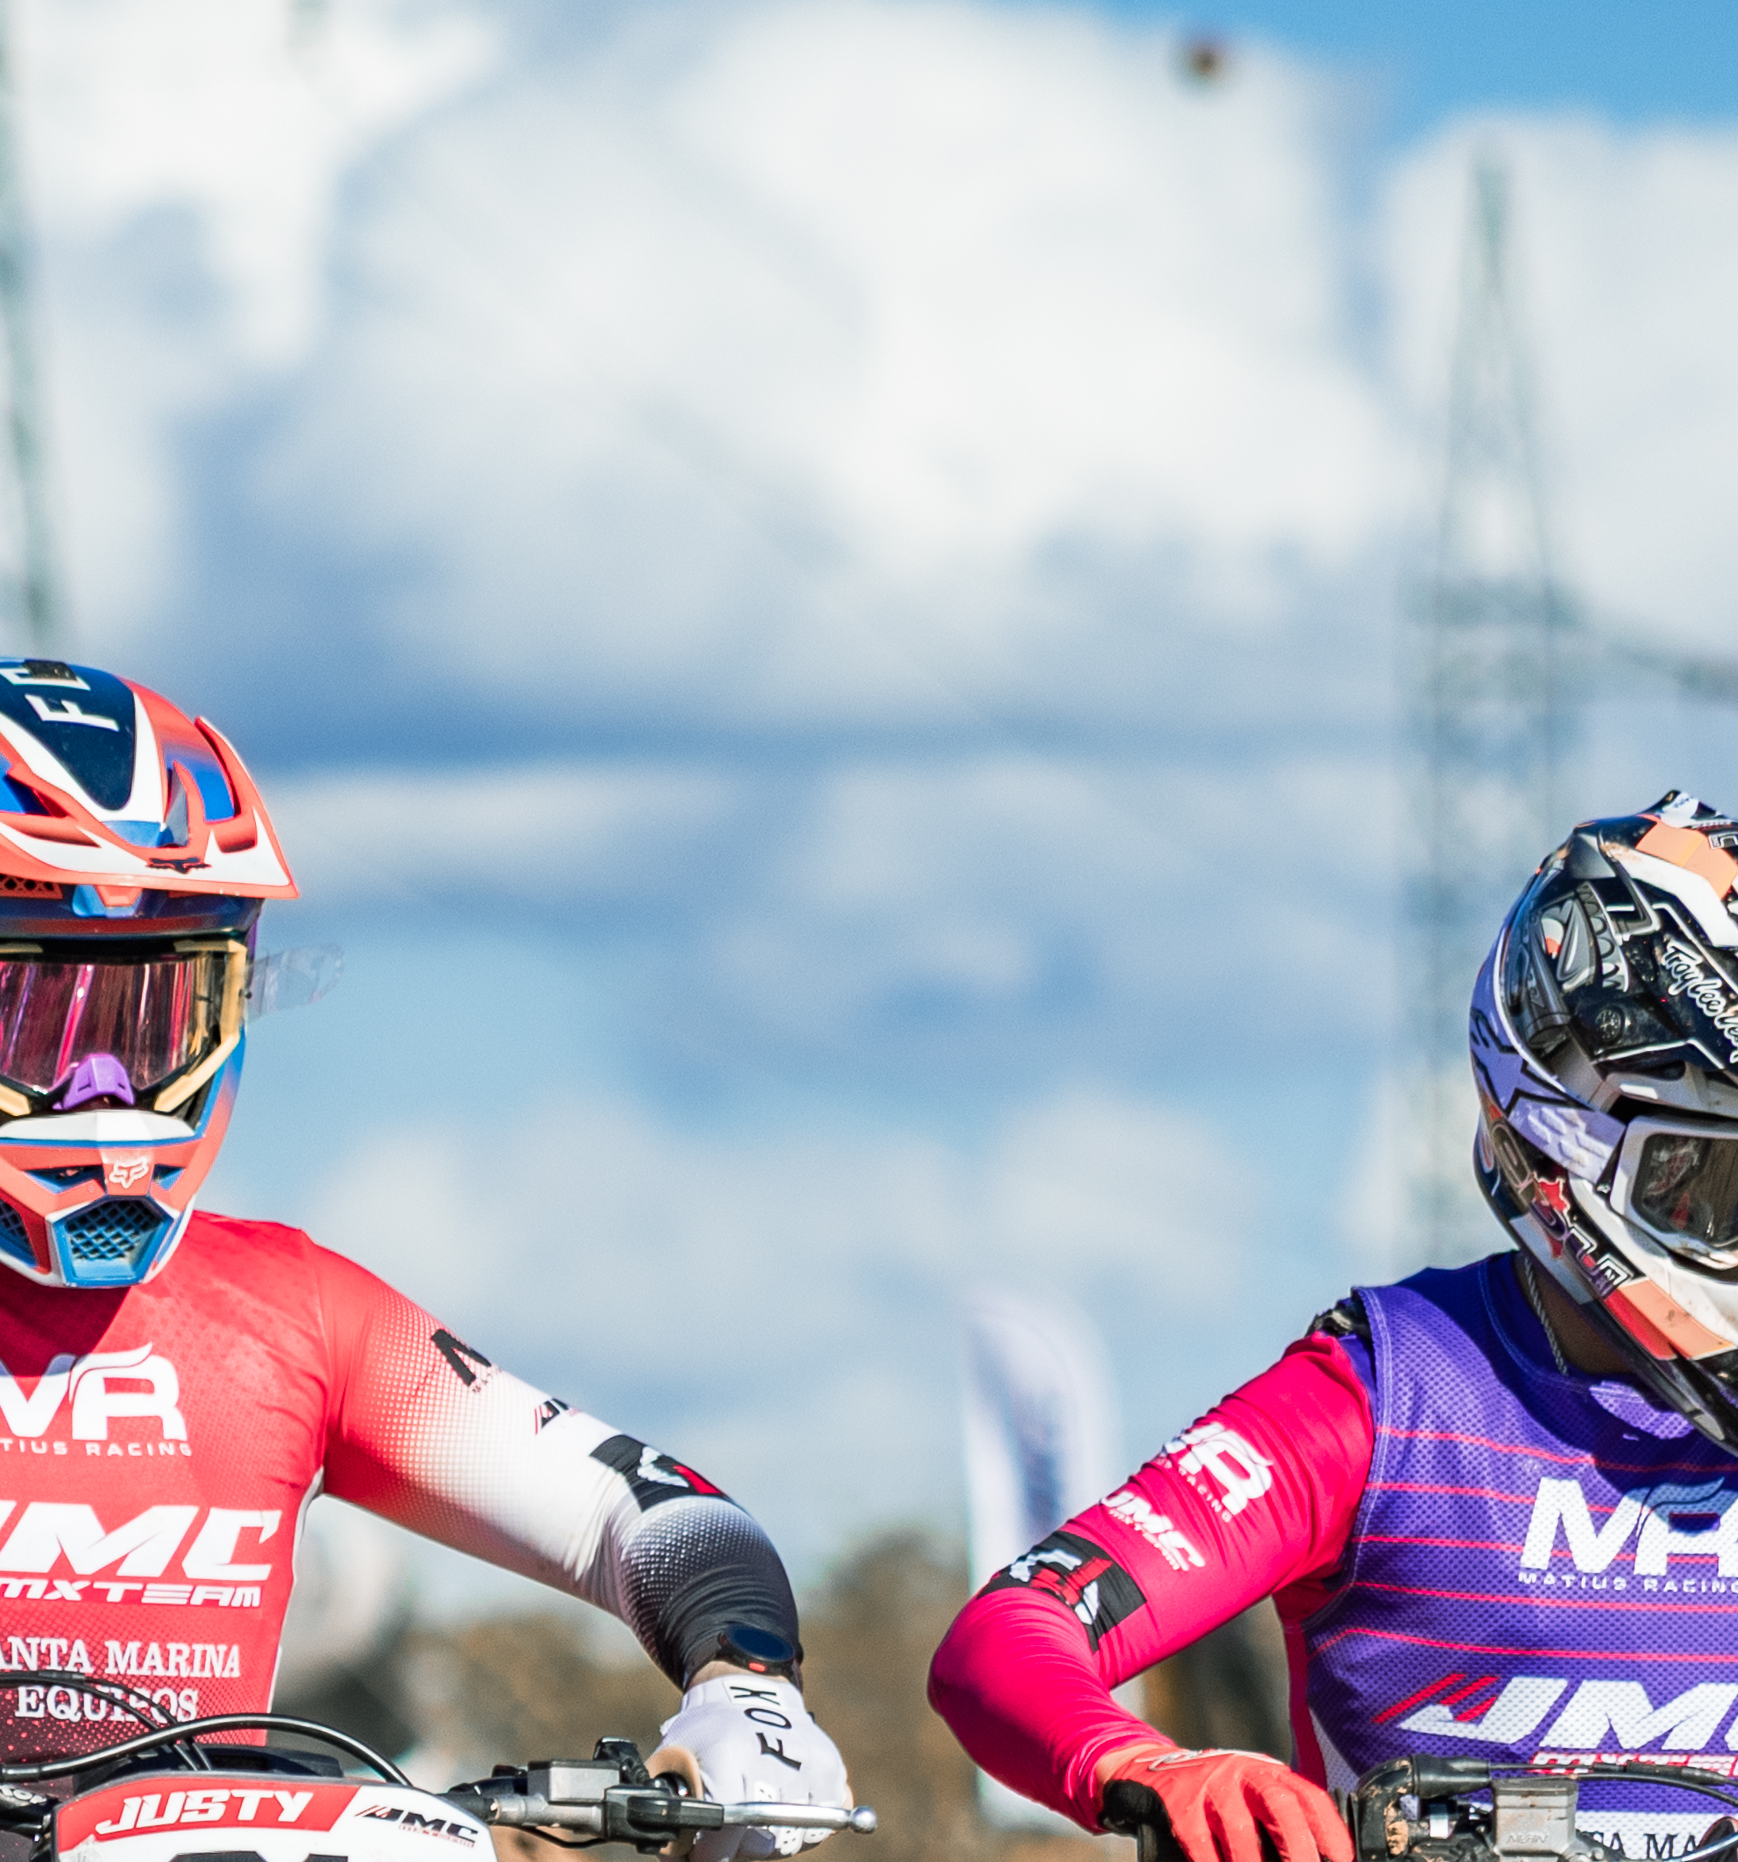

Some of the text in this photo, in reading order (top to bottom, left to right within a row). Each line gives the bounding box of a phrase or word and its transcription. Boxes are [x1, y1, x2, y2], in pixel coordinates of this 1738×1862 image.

[1663, 940, 1704, 995] Troy
[85, 1437, 192, 1457] RACING
[1517, 1571, 1628, 1593] MATIUS
[105, 1639, 241, 1680] MARINA
[729, 1685, 803, 1771] FOX
[95, 1788, 314, 1835] JUSTY
[361, 1807, 479, 1844] JMC
